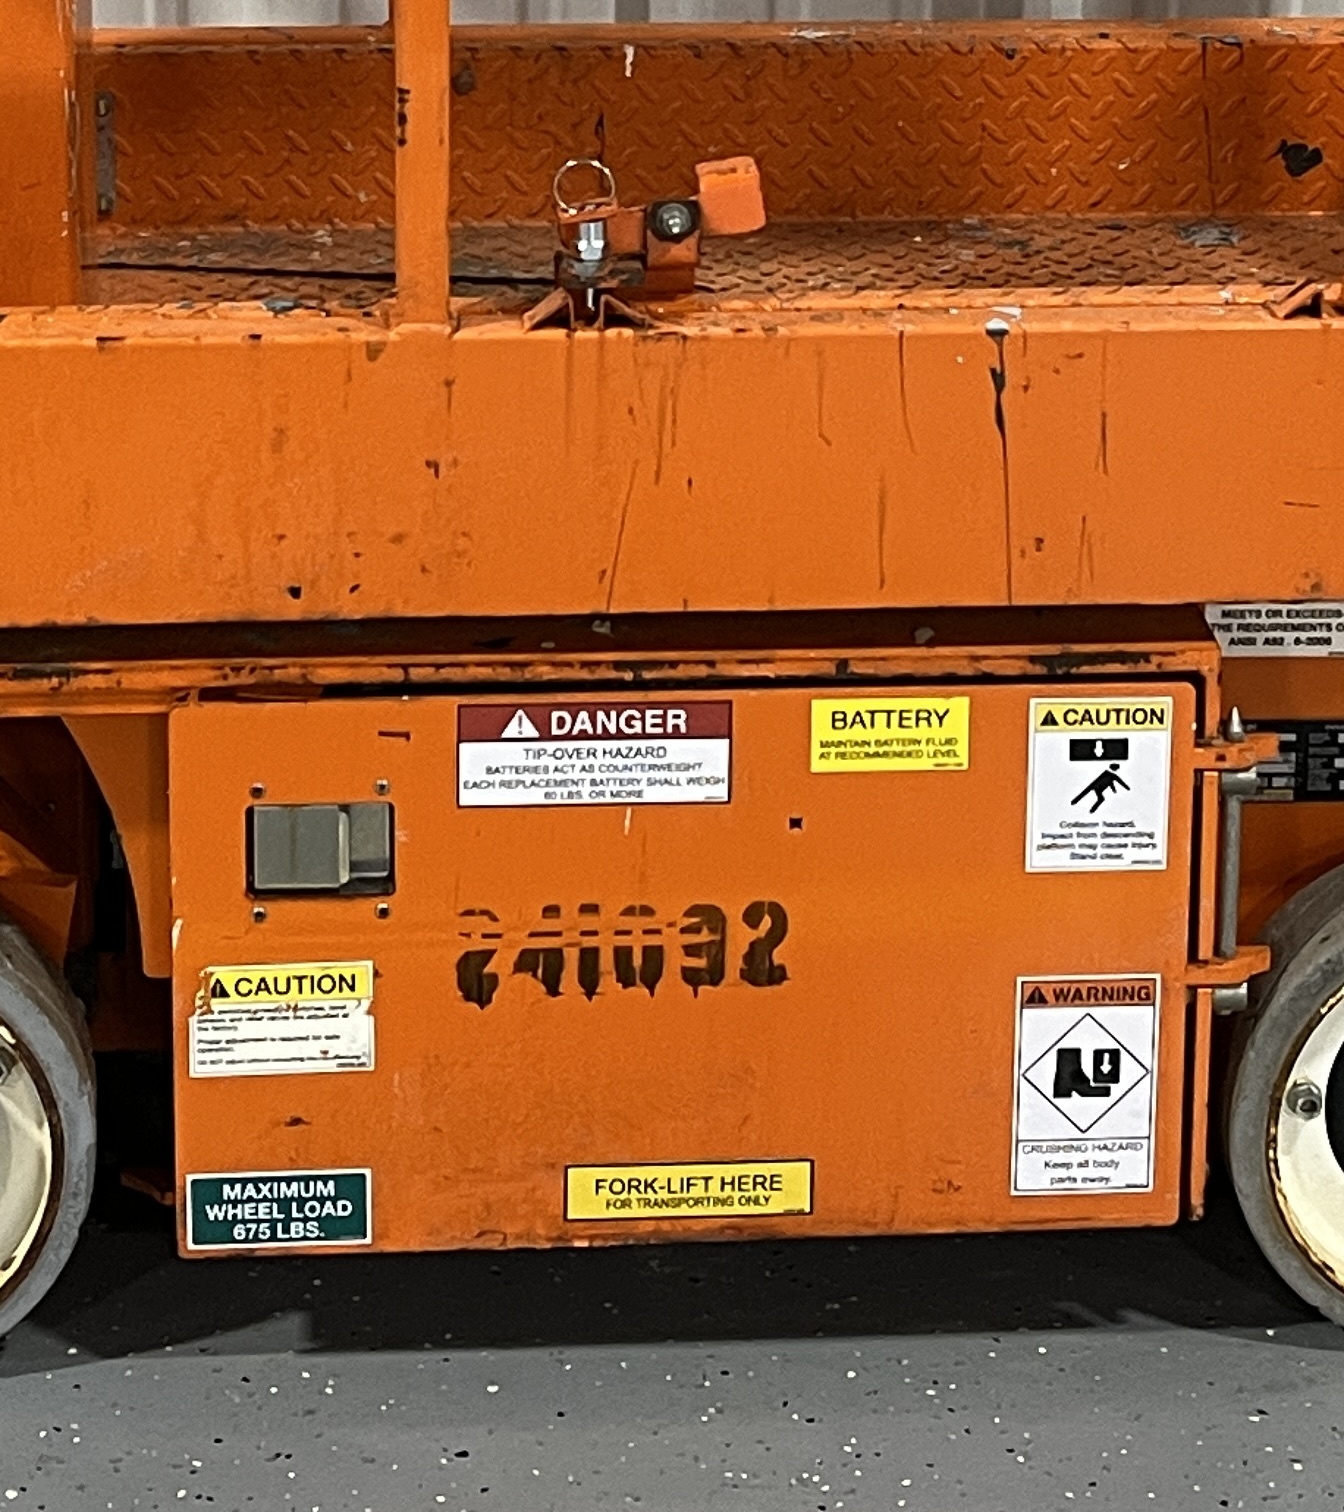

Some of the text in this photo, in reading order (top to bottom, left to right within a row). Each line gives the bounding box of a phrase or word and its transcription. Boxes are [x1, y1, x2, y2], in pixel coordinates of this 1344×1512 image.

[1265, 609, 1283, 619] OR
[550, 709, 687, 735] DANGER
[831, 708, 950, 730] BATTERY
[1063, 708, 1165, 726] CAUTION
[820, 737, 958, 749] MAINTAIN BATTERY FLUID
[523, 746, 666, 761] TIP-OVER HAZARD
[818, 749, 960, 760] AT RECOMMENDED LEVEL
[485, 762, 703, 775] BATTERIES ACT AS COUNTERWEIGHT
[463, 780, 496, 790] EACH
[499, 778, 586, 789] REPLACEMENT
[589, 777, 643, 788] BATTERY
[646, 776, 682, 787] SHALL
[588, 789, 606, 799] OR
[610, 789, 644, 799] MORE
[234, 973, 356, 997] CAUTION
[1052, 985, 1151, 1003] WARNING
[1022, 1142, 1144, 1154] CRUSHING HAZARD
[222, 1180, 335, 1200] MAXIMUM
[595, 1174, 783, 1195] FORK-LIFT HERE
[206, 1199, 353, 1221] WHEEL LOAD
[605, 1194, 772, 1210] FOR TRANSPORTING ONLY
[233, 1221, 326, 1240] 675 LBS.
